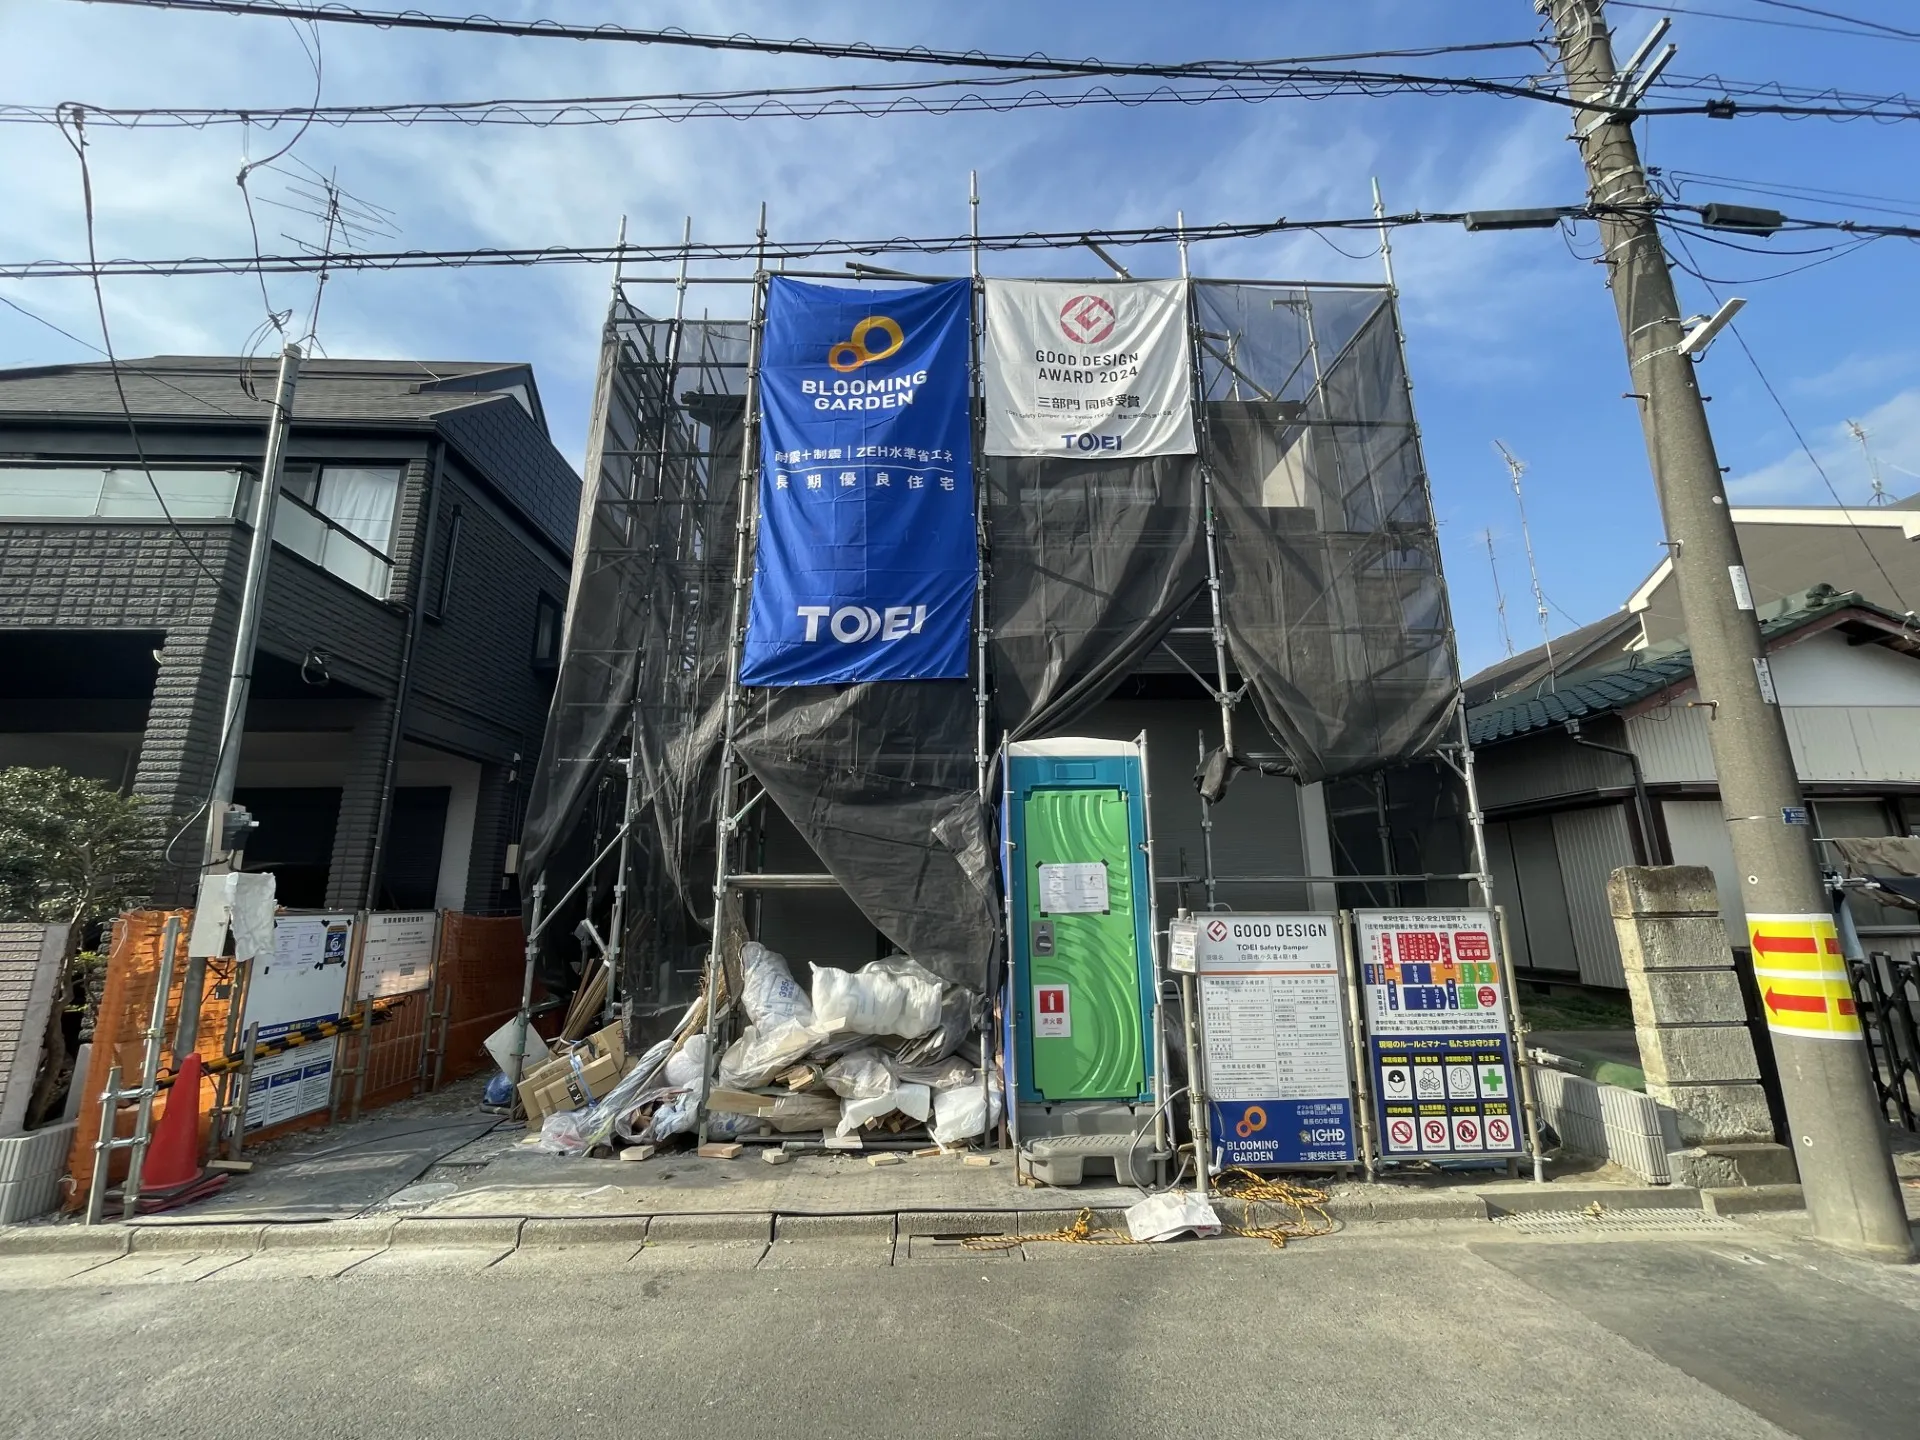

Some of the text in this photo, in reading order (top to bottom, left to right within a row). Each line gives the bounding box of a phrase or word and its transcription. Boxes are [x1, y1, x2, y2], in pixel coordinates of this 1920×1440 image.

[1036, 350, 1139, 367] GOOD DESIGN
[802, 370, 928, 396] BLOOMING
[1038, 366, 1139, 384] AWARD 2024
[814, 389, 914, 411] GARDEN
[1038, 393, 1141, 411] 三部門 同時受賞
[856, 445, 954, 464] ZEH水準省エネ
[775, 471, 956, 492] 長期優良住宅
[1234, 923, 1327, 938] GOOD DESIGN
[1378, 1039, 1501, 1049] 現場のルールとマナー 私たちは守ります
[1227, 1140, 1279, 1151] BLOOMING
[1233, 1151, 1274, 1162] GARDEN
[1307, 1150, 1347, 1161] 東栄住宅
